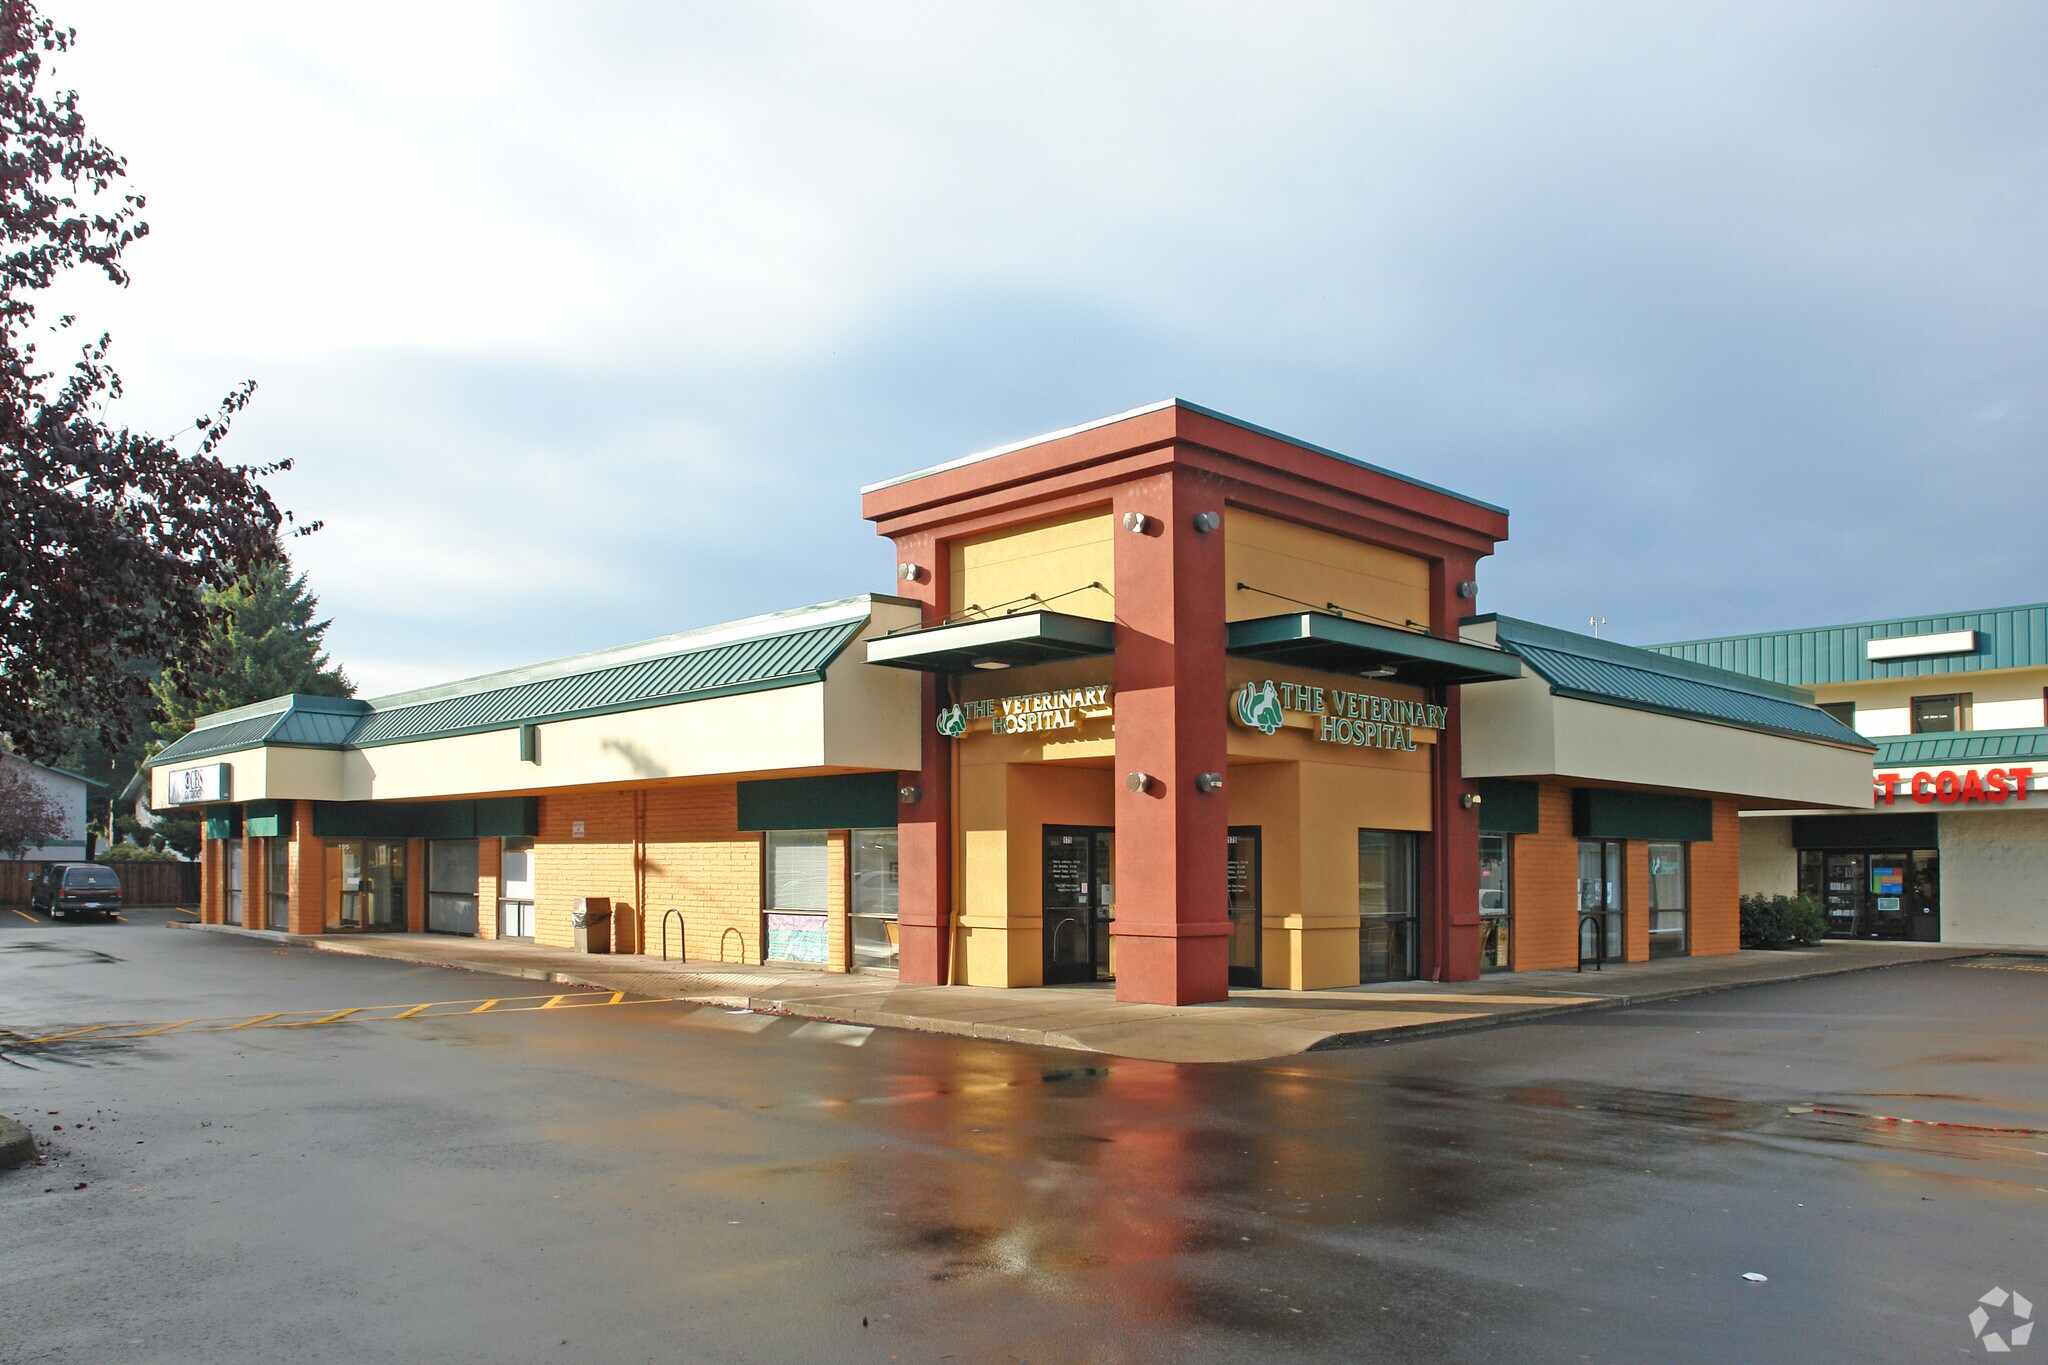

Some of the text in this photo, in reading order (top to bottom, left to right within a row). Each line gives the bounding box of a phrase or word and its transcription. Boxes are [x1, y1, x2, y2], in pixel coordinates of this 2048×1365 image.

[964, 685, 1108, 719] THE VETERINARY
[1280, 682, 1448, 730] THE VETERINARY
[992, 708, 1075, 735] HOSPITAL
[1320, 715, 1417, 752] HOSPITAL
[1873, 767, 2033, 806] T COAST
